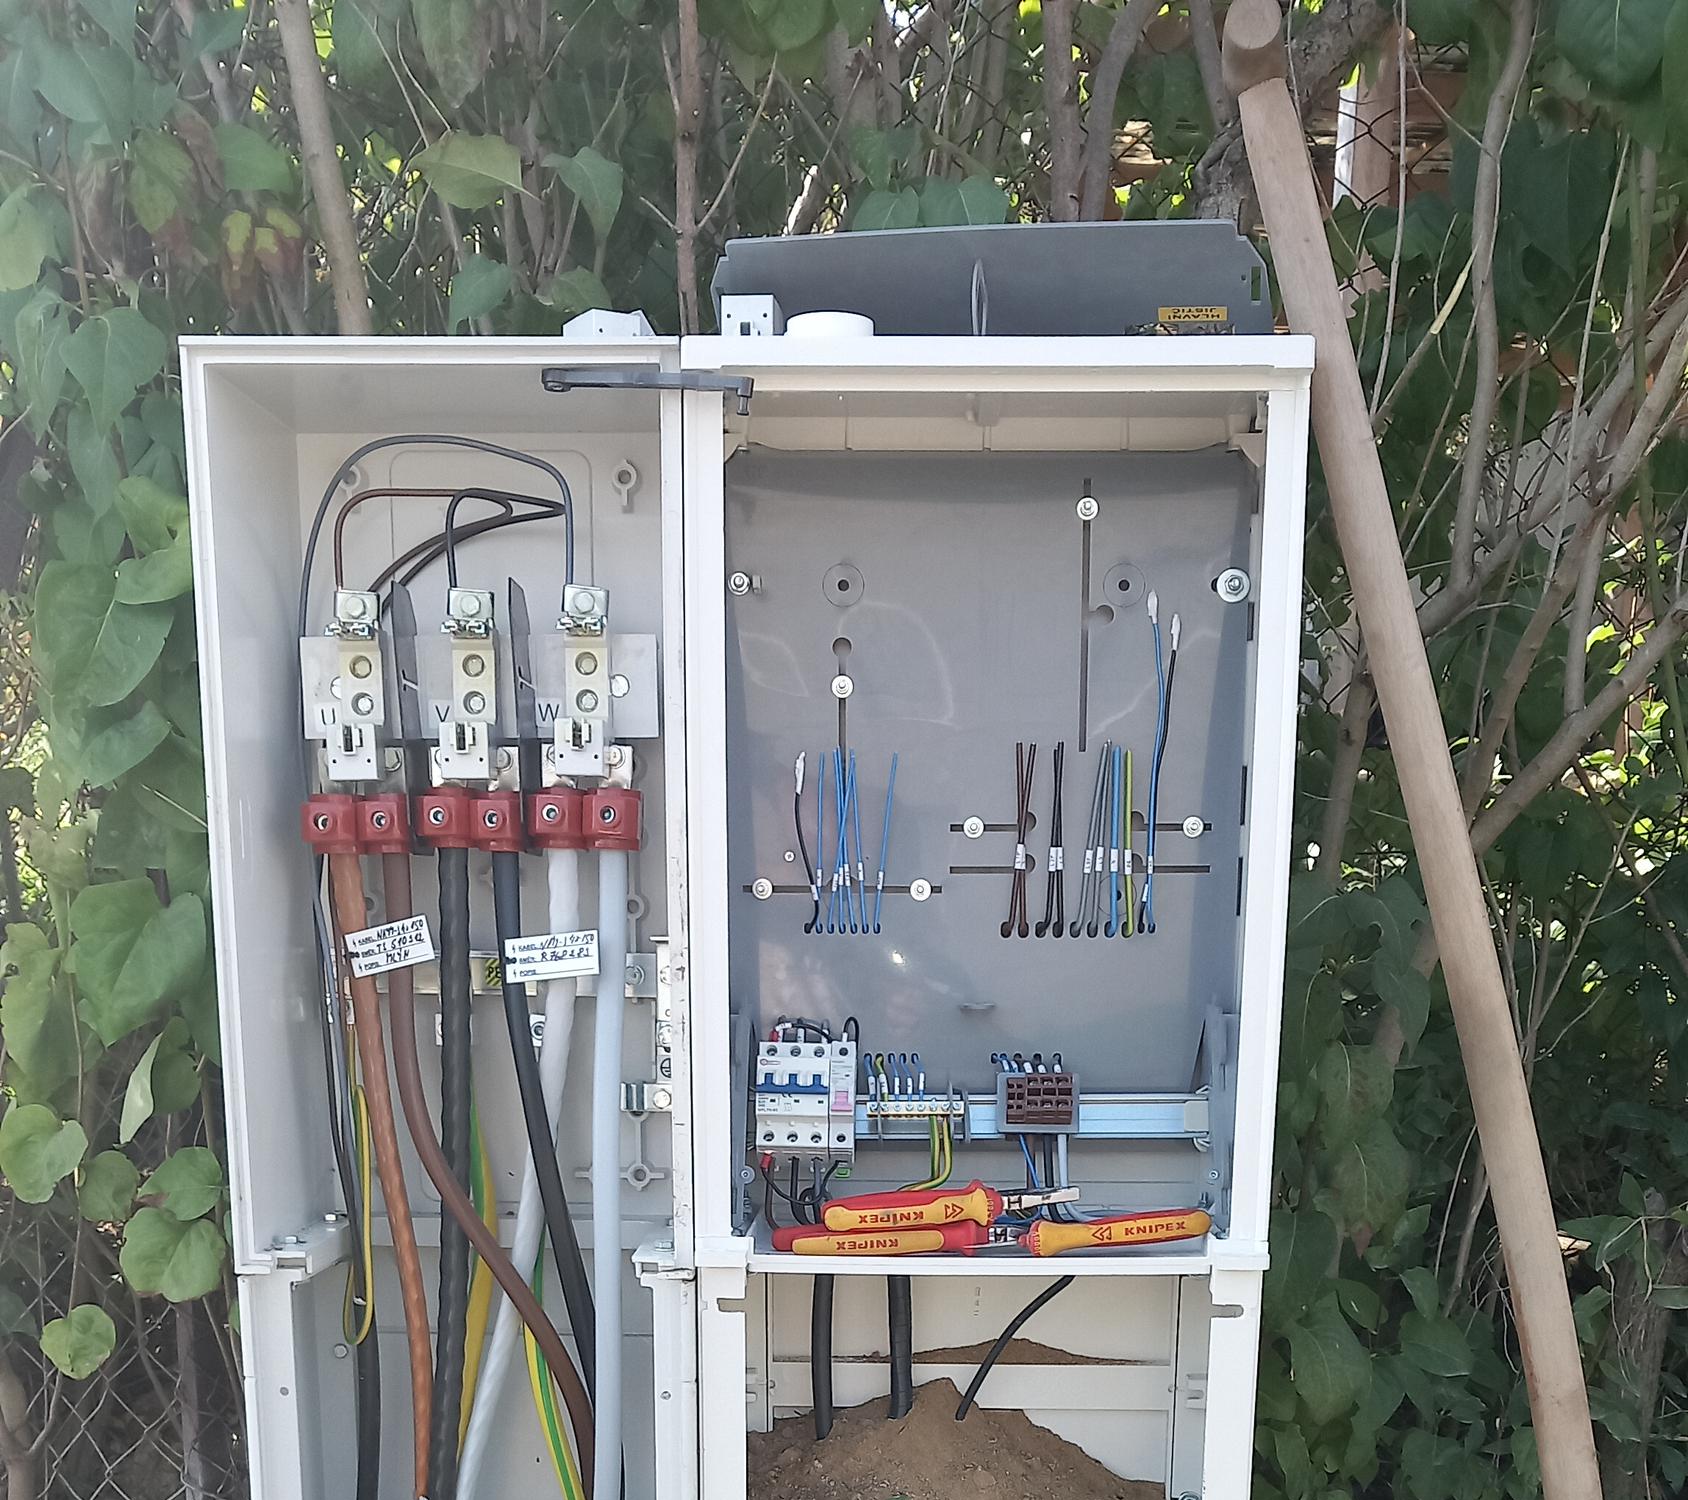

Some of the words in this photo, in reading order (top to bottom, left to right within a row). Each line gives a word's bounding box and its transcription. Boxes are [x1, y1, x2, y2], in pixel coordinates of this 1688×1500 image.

[320, 708, 336, 725] U
[434, 704, 450, 723] V
[537, 703, 560, 722] W
[858, 1211, 924, 1224] KNIPEX
[1124, 1221, 1187, 1236] KNIPEX
[836, 1238, 899, 1250] KNIPEX
